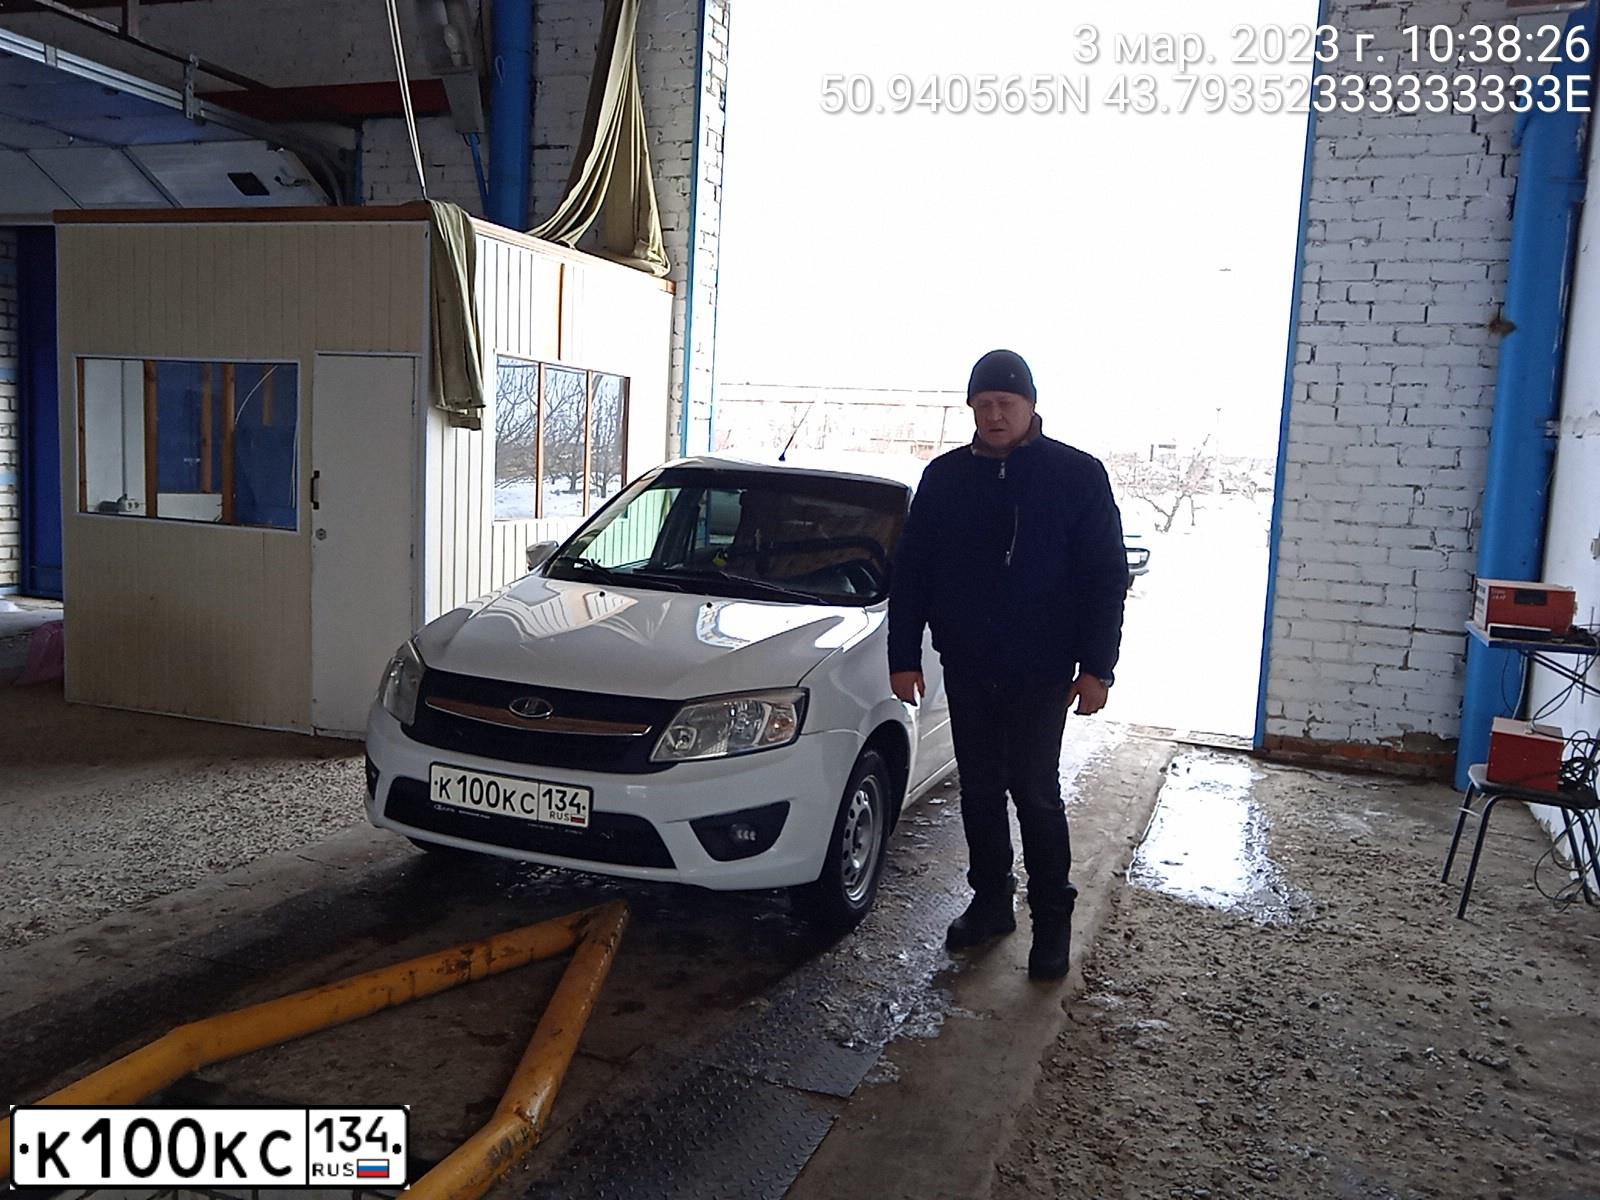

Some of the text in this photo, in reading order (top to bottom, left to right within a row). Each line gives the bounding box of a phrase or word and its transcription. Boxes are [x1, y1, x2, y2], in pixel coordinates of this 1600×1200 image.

[438, 775, 535, 815] К100КС
[542, 788, 581, 814] 134
[549, 811, 570, 822] RUS
